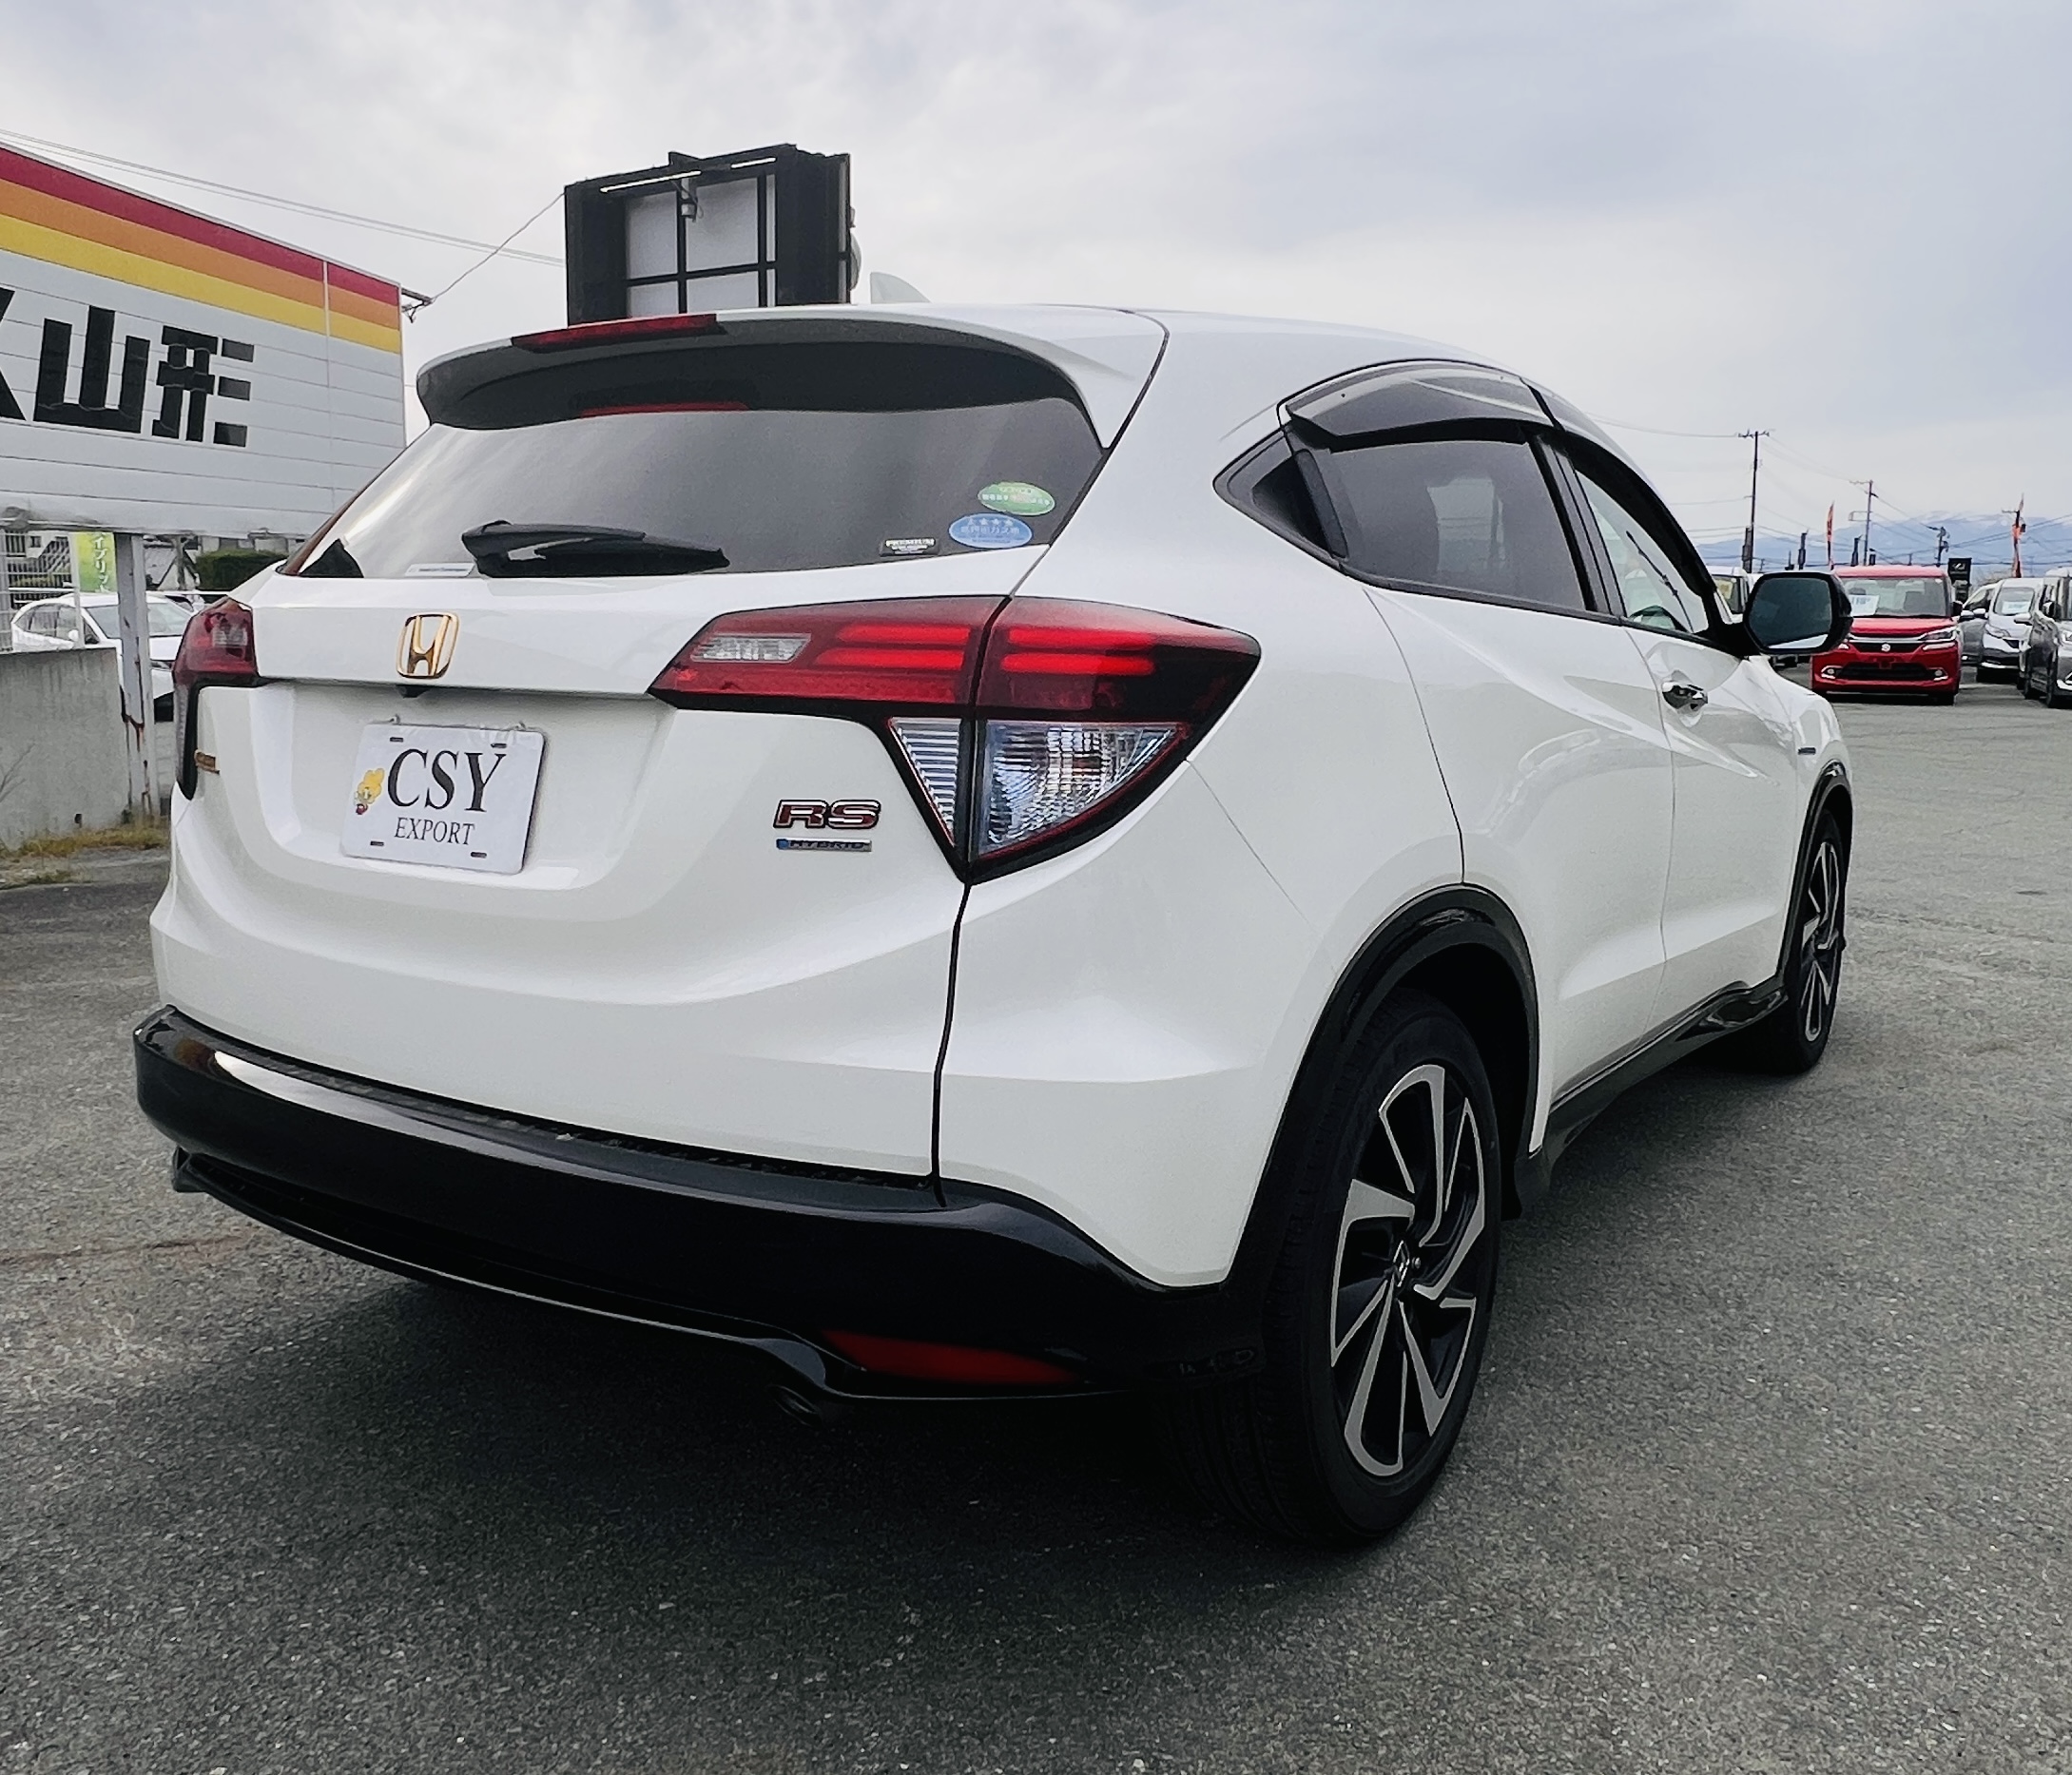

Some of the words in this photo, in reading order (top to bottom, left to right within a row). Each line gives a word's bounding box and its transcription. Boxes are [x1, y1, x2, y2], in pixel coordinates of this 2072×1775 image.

[388, 749, 506, 813] CSY
[773, 800, 881, 829] RS
[395, 817, 475, 845] EXPORT
